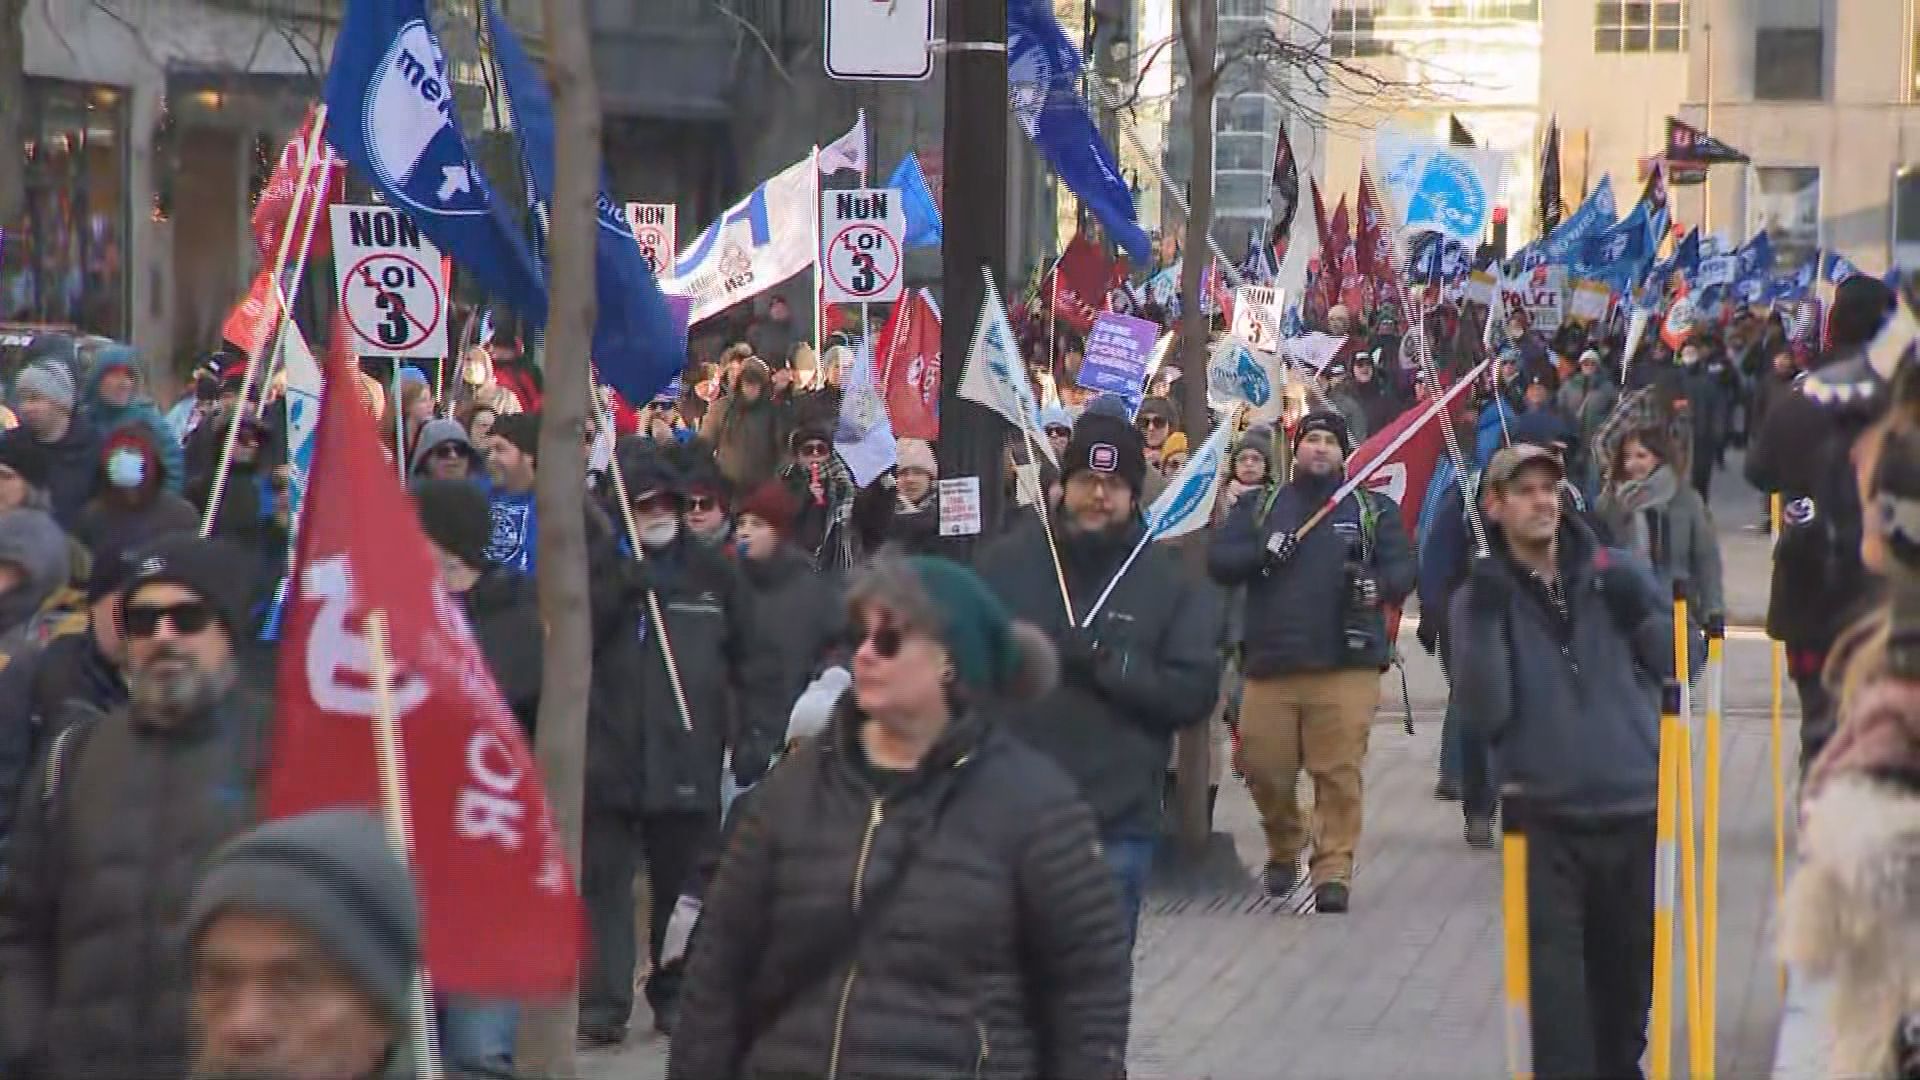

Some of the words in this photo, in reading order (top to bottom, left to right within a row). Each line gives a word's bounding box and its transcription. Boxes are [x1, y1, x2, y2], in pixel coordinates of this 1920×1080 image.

[634, 206, 665, 224] NON
[350, 211, 420, 248] NON
[845, 234, 882, 250] LOI
[358, 265, 416, 288] LOI
[852, 254, 874, 291] 3
[1247, 289, 1275, 305] NON
[1502, 290, 1558, 308] POLICE
[376, 292, 408, 344] 3
[1248, 321, 1261, 343] 3
